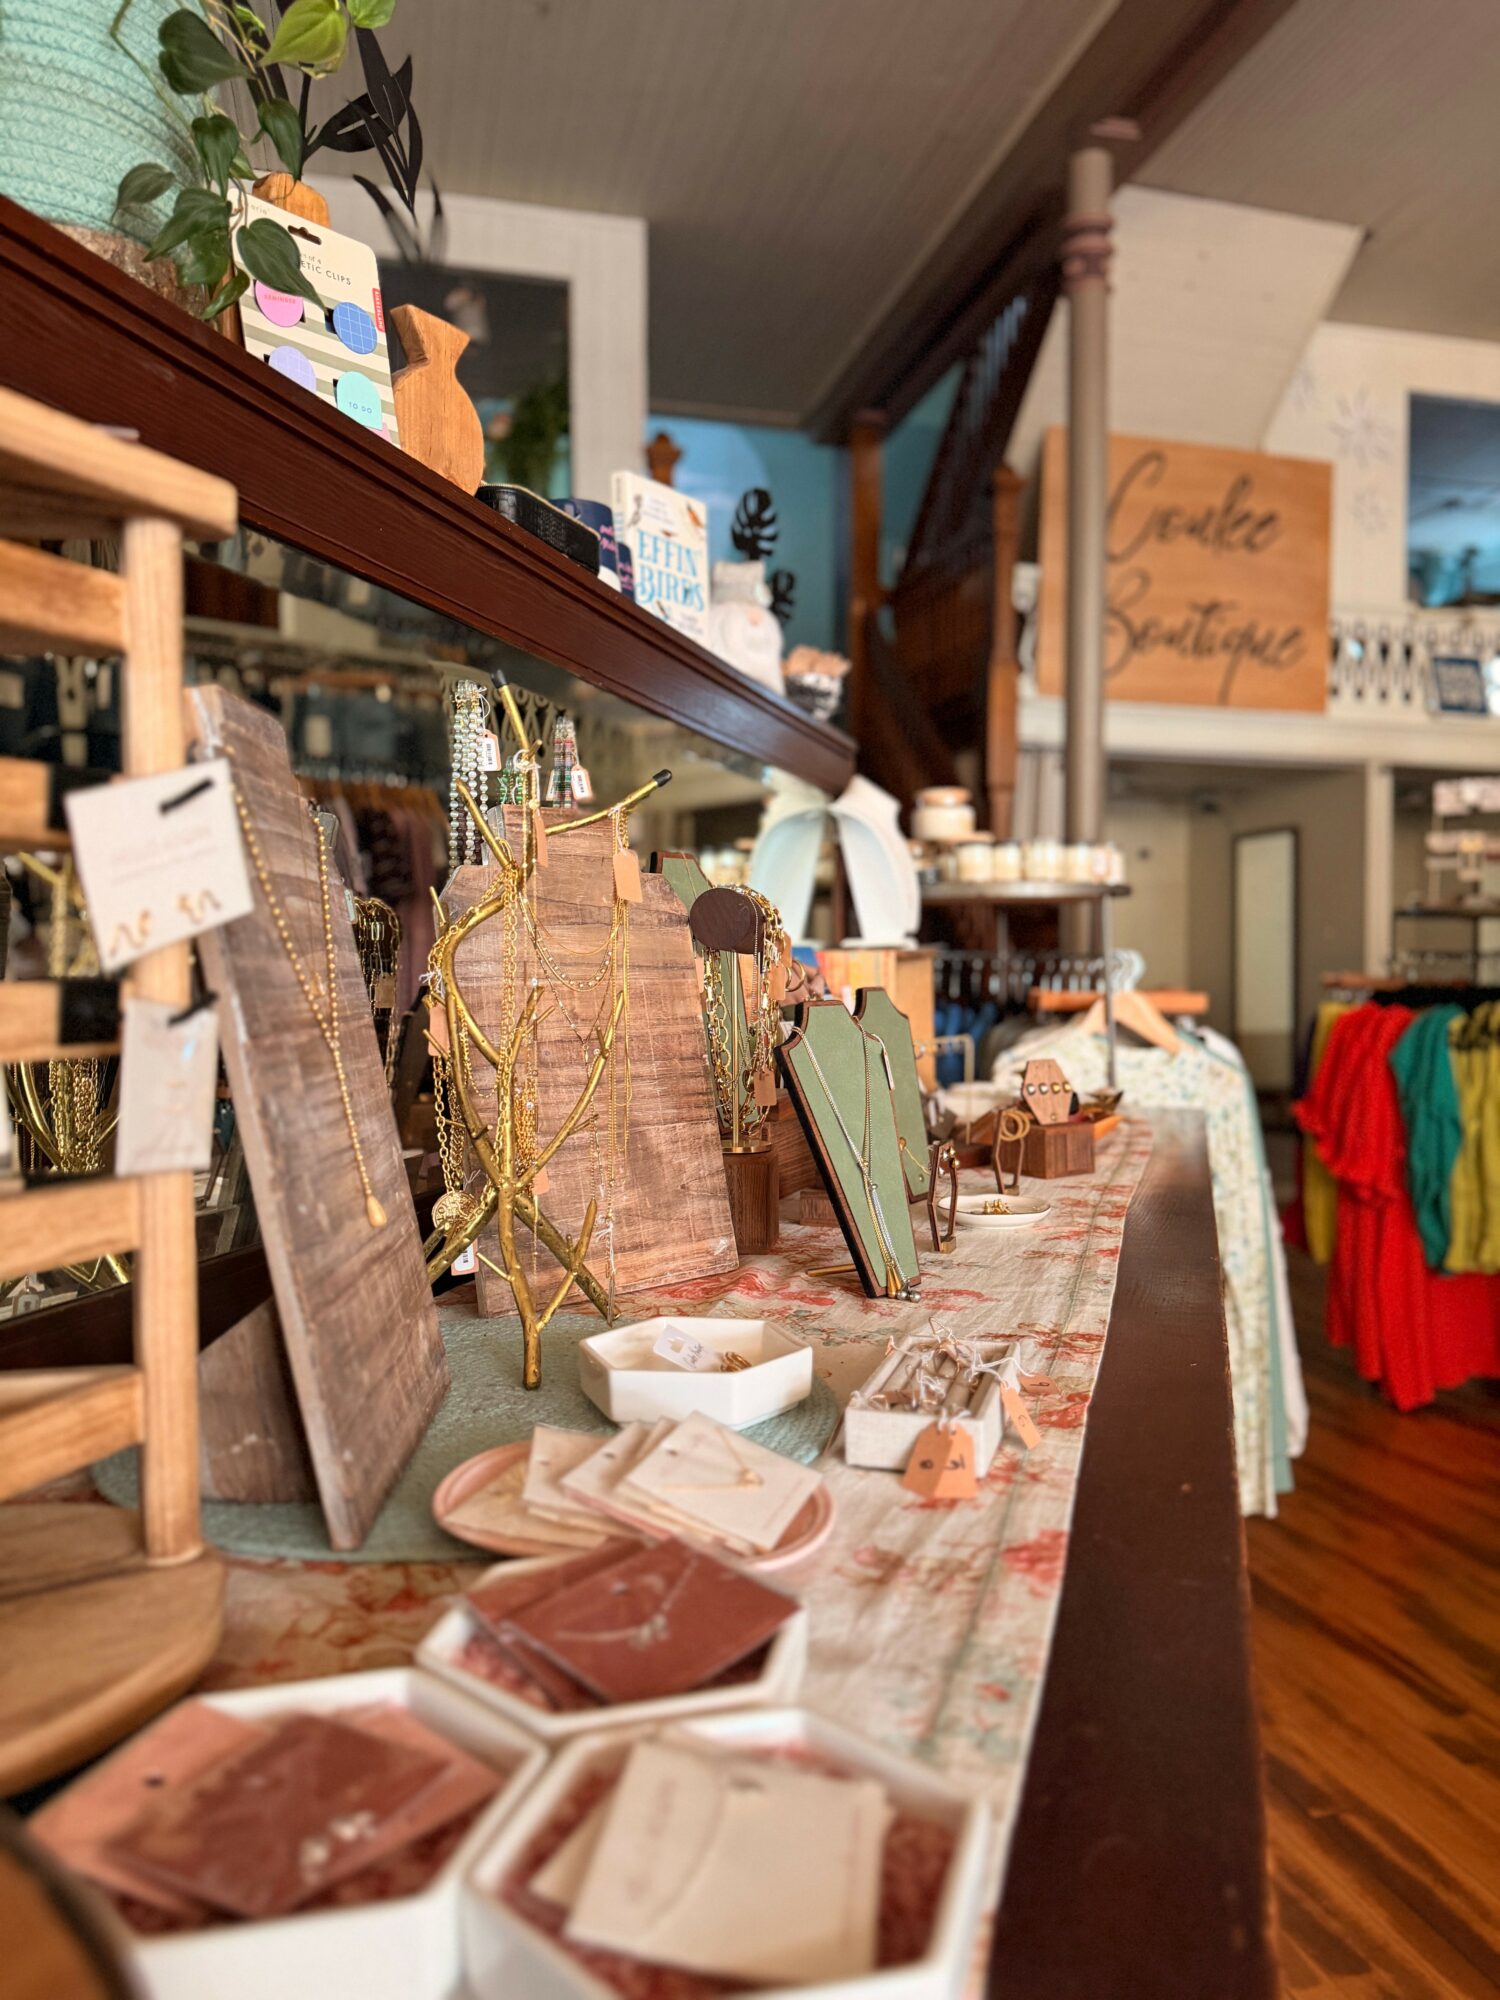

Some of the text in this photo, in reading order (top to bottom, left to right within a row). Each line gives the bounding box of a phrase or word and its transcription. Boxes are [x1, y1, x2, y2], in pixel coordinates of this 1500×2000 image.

[300, 260, 351, 286] ETIC CLIPS
[348, 401, 373, 415] TO DO
[635, 565, 704, 612] BIRDS
